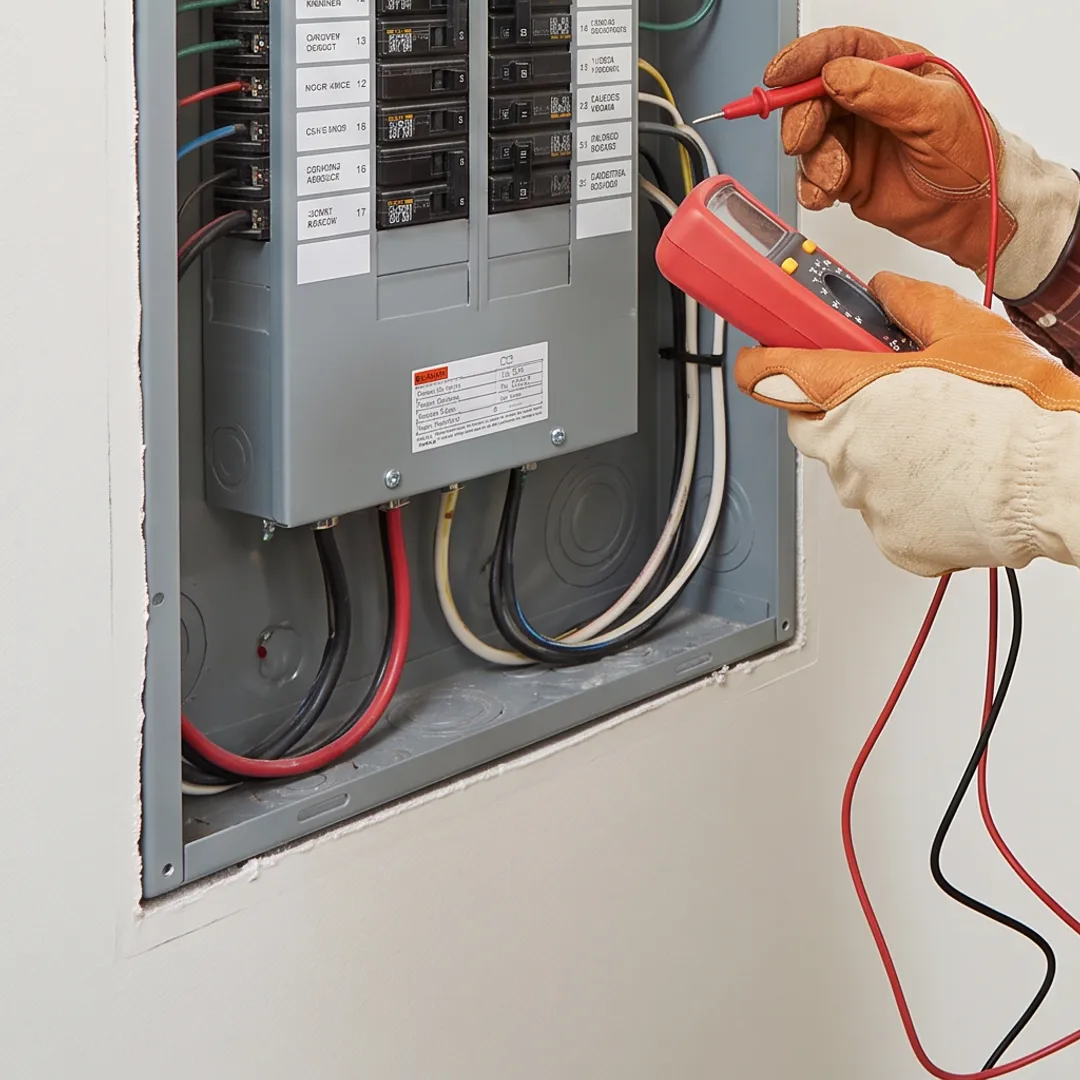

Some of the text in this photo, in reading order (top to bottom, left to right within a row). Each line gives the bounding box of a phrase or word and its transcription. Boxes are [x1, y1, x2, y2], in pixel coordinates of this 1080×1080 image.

[357, 36, 366, 45] 13
[357, 79, 366, 88] 12
[357, 208, 366, 217] 17
